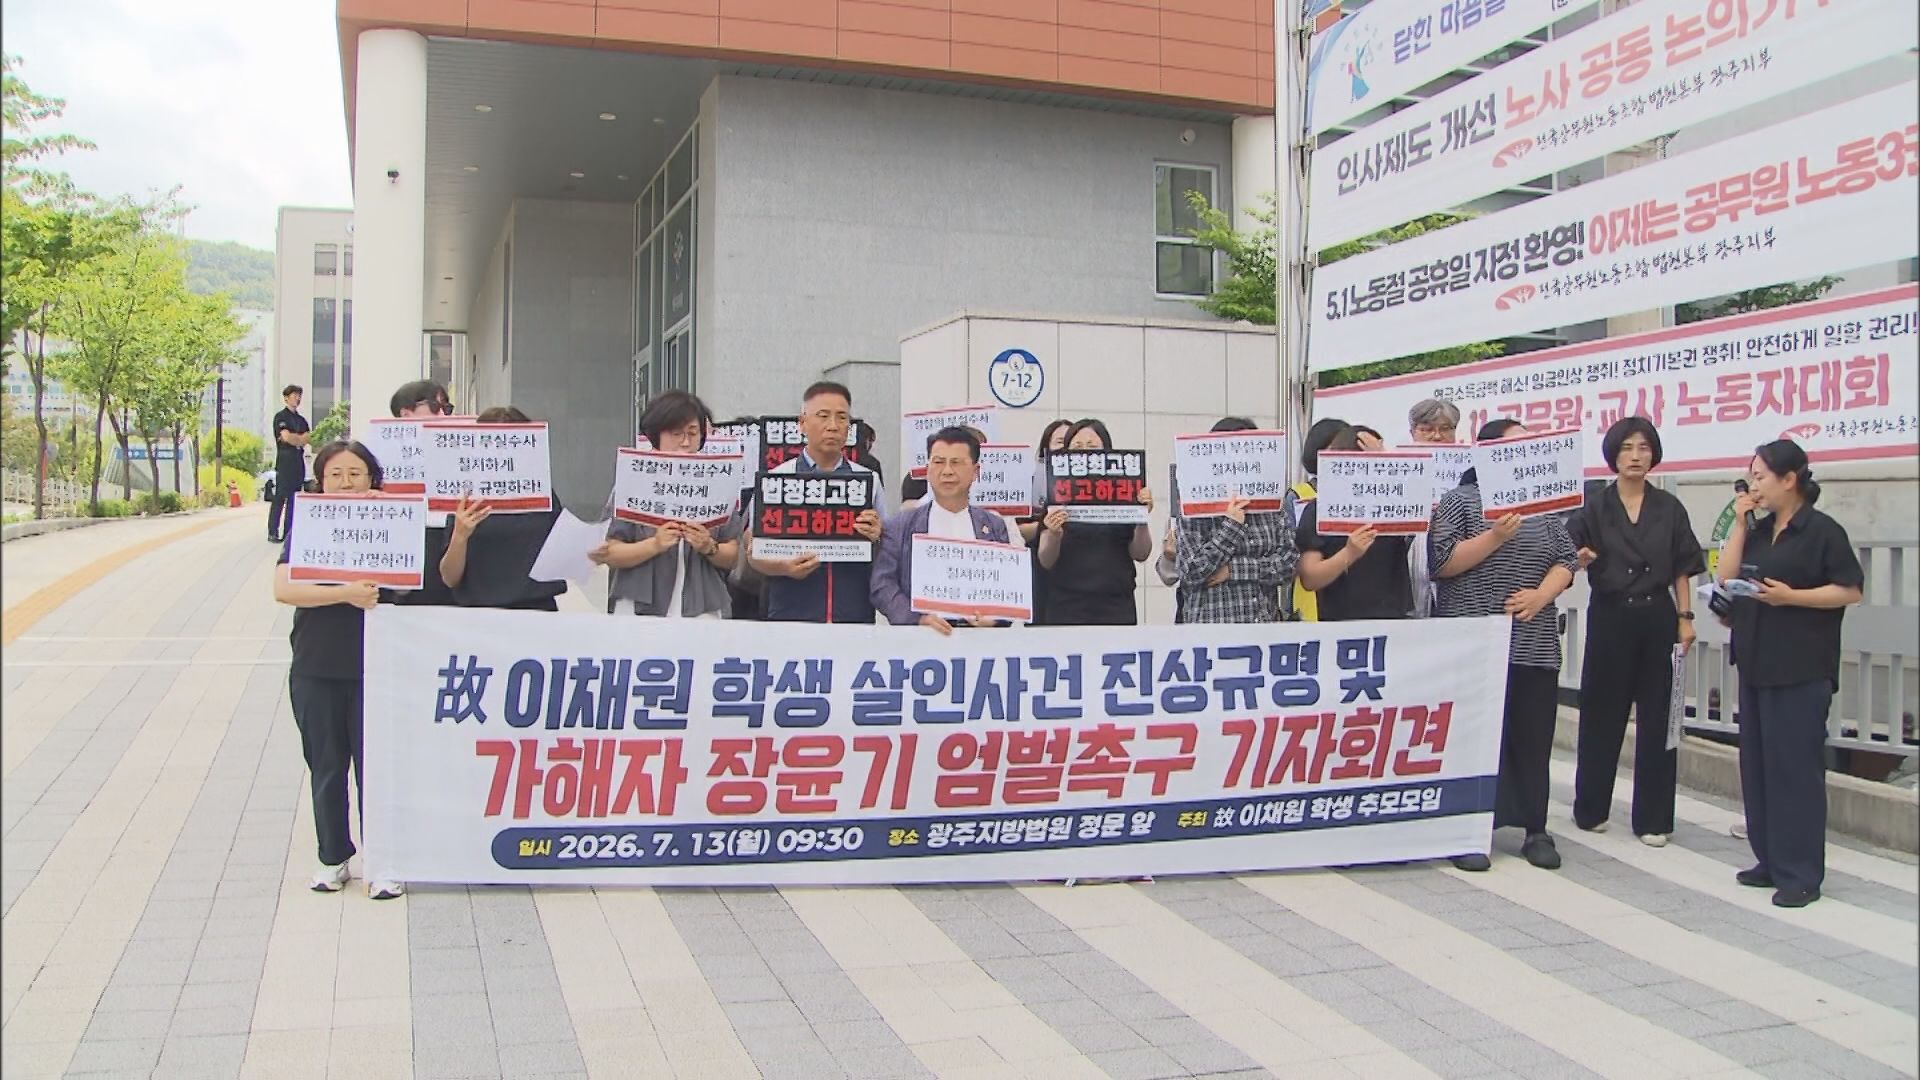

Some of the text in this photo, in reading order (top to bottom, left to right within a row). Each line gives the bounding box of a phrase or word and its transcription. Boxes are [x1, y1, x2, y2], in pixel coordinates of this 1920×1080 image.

[1393, 15, 1433, 65] 닫힌
[1336, 121, 1433, 196] 인사제도
[1440, 93, 1497, 153] 개선
[1504, 62, 1571, 129] 노사
[1578, 25, 1653, 98] 공동
[1407, 253, 1471, 302] 공휴일
[1473, 239, 1520, 283] 지정
[1523, 221, 1585, 273] 환영!
[1588, 199, 1681, 255] 이제는
[1683, 161, 1790, 233] 공무원
[1501, 374, 1529, 394] 해소!
[1531, 367, 1582, 390] 임금인상
[1586, 361, 1619, 383] 쟁취!
[1622, 348, 1698, 378] 정치기본권
[1701, 341, 1741, 366] 쟁취!
[1746, 328, 1818, 359] 안전하게
[1823, 322, 1862, 347] 일할
[1867, 311, 1918, 341] 권리!
[1001, 372, 1033, 388] 7-12
[1676, 353, 1890, 427] 노동자대회
[434, 433, 537, 448] 경찰의 부실수사
[459, 457, 515, 472] 철저하게
[631, 459, 733, 478] 경찰의 부실수사
[1052, 453, 1140, 476] 법정최고형
[1330, 461, 1424, 476] 경찰의 부실수사
[479, 479, 541, 495] 규명하라!
[653, 481, 709, 498] 철저하게
[762, 477, 867, 506] 법정최고형
[1351, 483, 1403, 497] 철저하게
[310, 503, 413, 520] 경찰의 부실수사
[1370, 503, 1425, 518] 규명하라!
[331, 527, 389, 543] 철저하게
[350, 551, 415, 567] 규명하라!
[435, 635, 1389, 730] 故 이채원 학생 살인사건 진상규명 및
[475, 702, 1454, 820] 가해자 장윤기 엄벌촉구 기자회견
[518, 786, 1443, 859] 일시 2026. 7. 13(월) 09:30 장소 광주지방법원 정문 앞 주최 故 이채원 학생 추모모임
